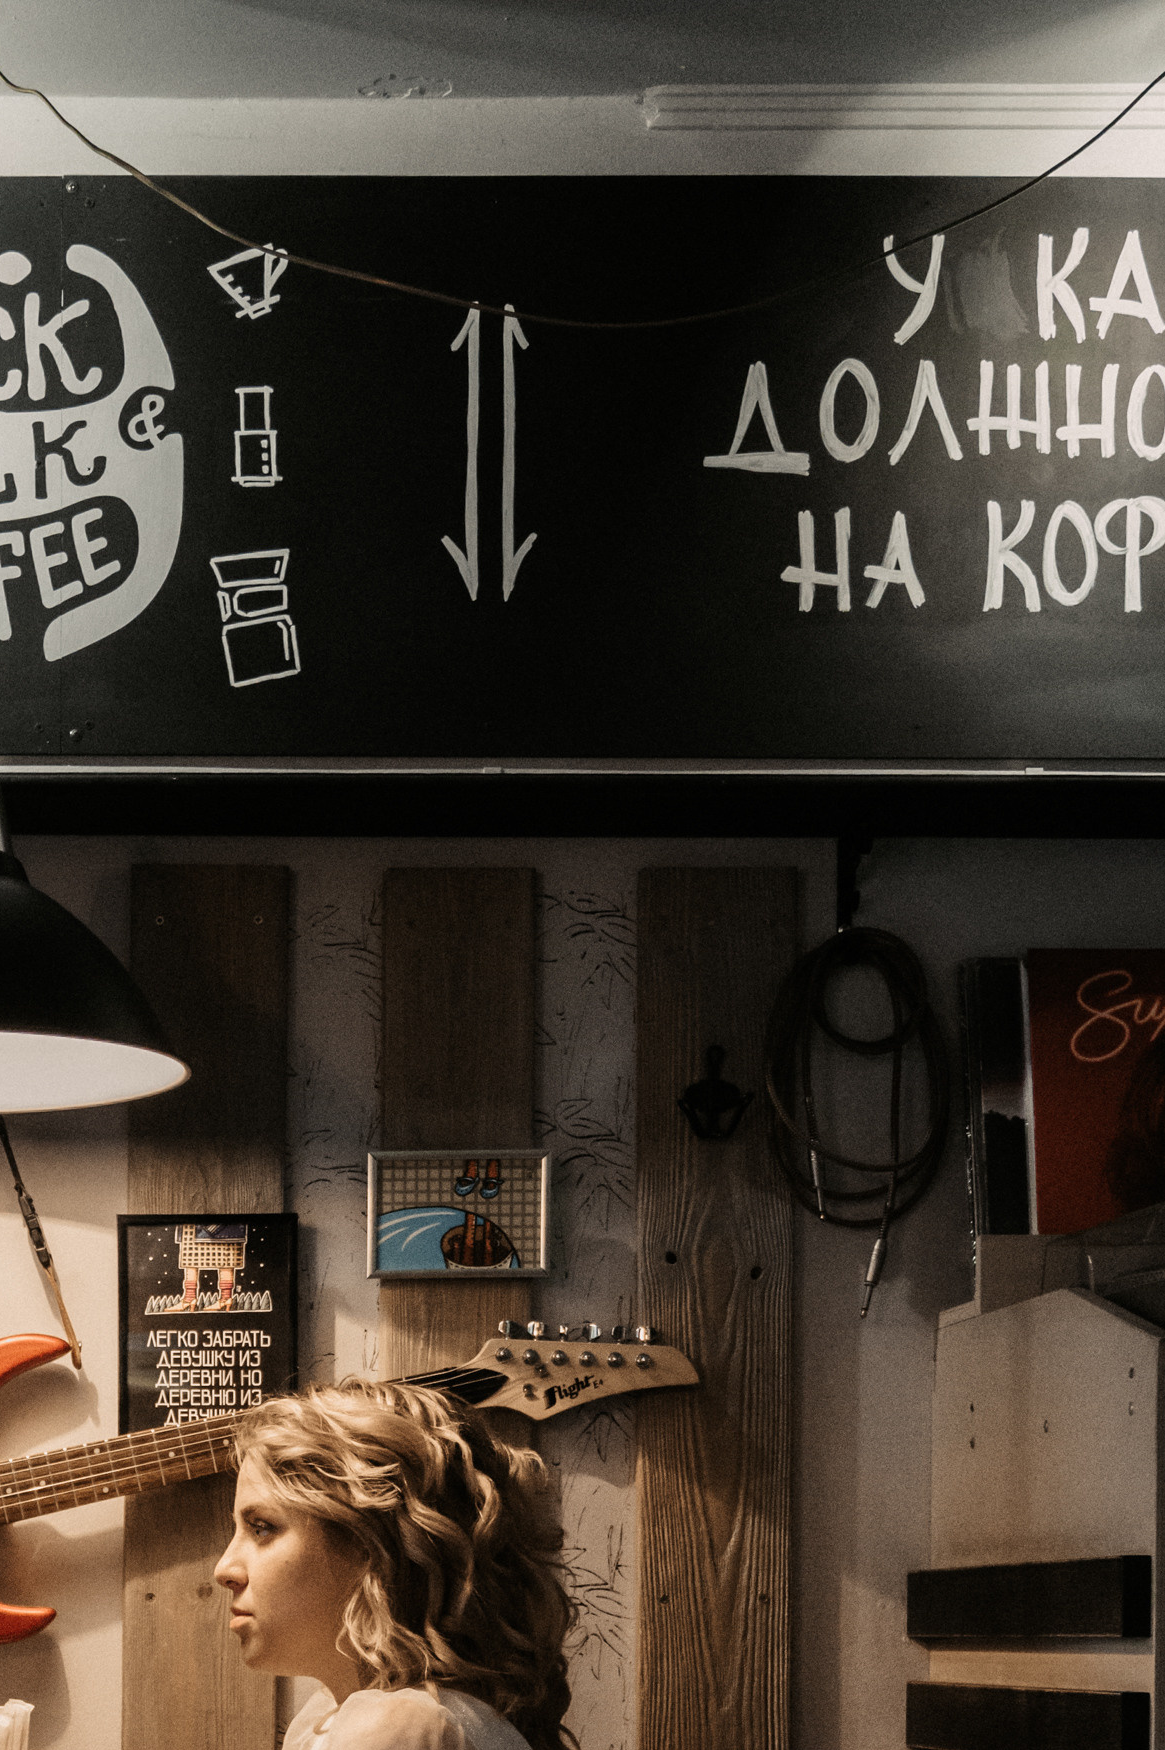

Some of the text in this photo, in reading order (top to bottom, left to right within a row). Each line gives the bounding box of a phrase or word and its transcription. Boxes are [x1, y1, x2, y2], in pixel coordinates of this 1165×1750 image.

[883, 234, 945, 345] У
[127, 394, 165, 448] &
[780, 506, 926, 612] НА
[147, 1330, 271, 1348] ЛЕГКО ЗАБРАТЬ
[156, 1350, 261, 1368] ДЕВУШКУ ИЗ
[155, 1369, 262, 1388] ДЕРЕВНИ, НО
[155, 1389, 262, 1408] ДЕРЕВНЮ ИЗ
